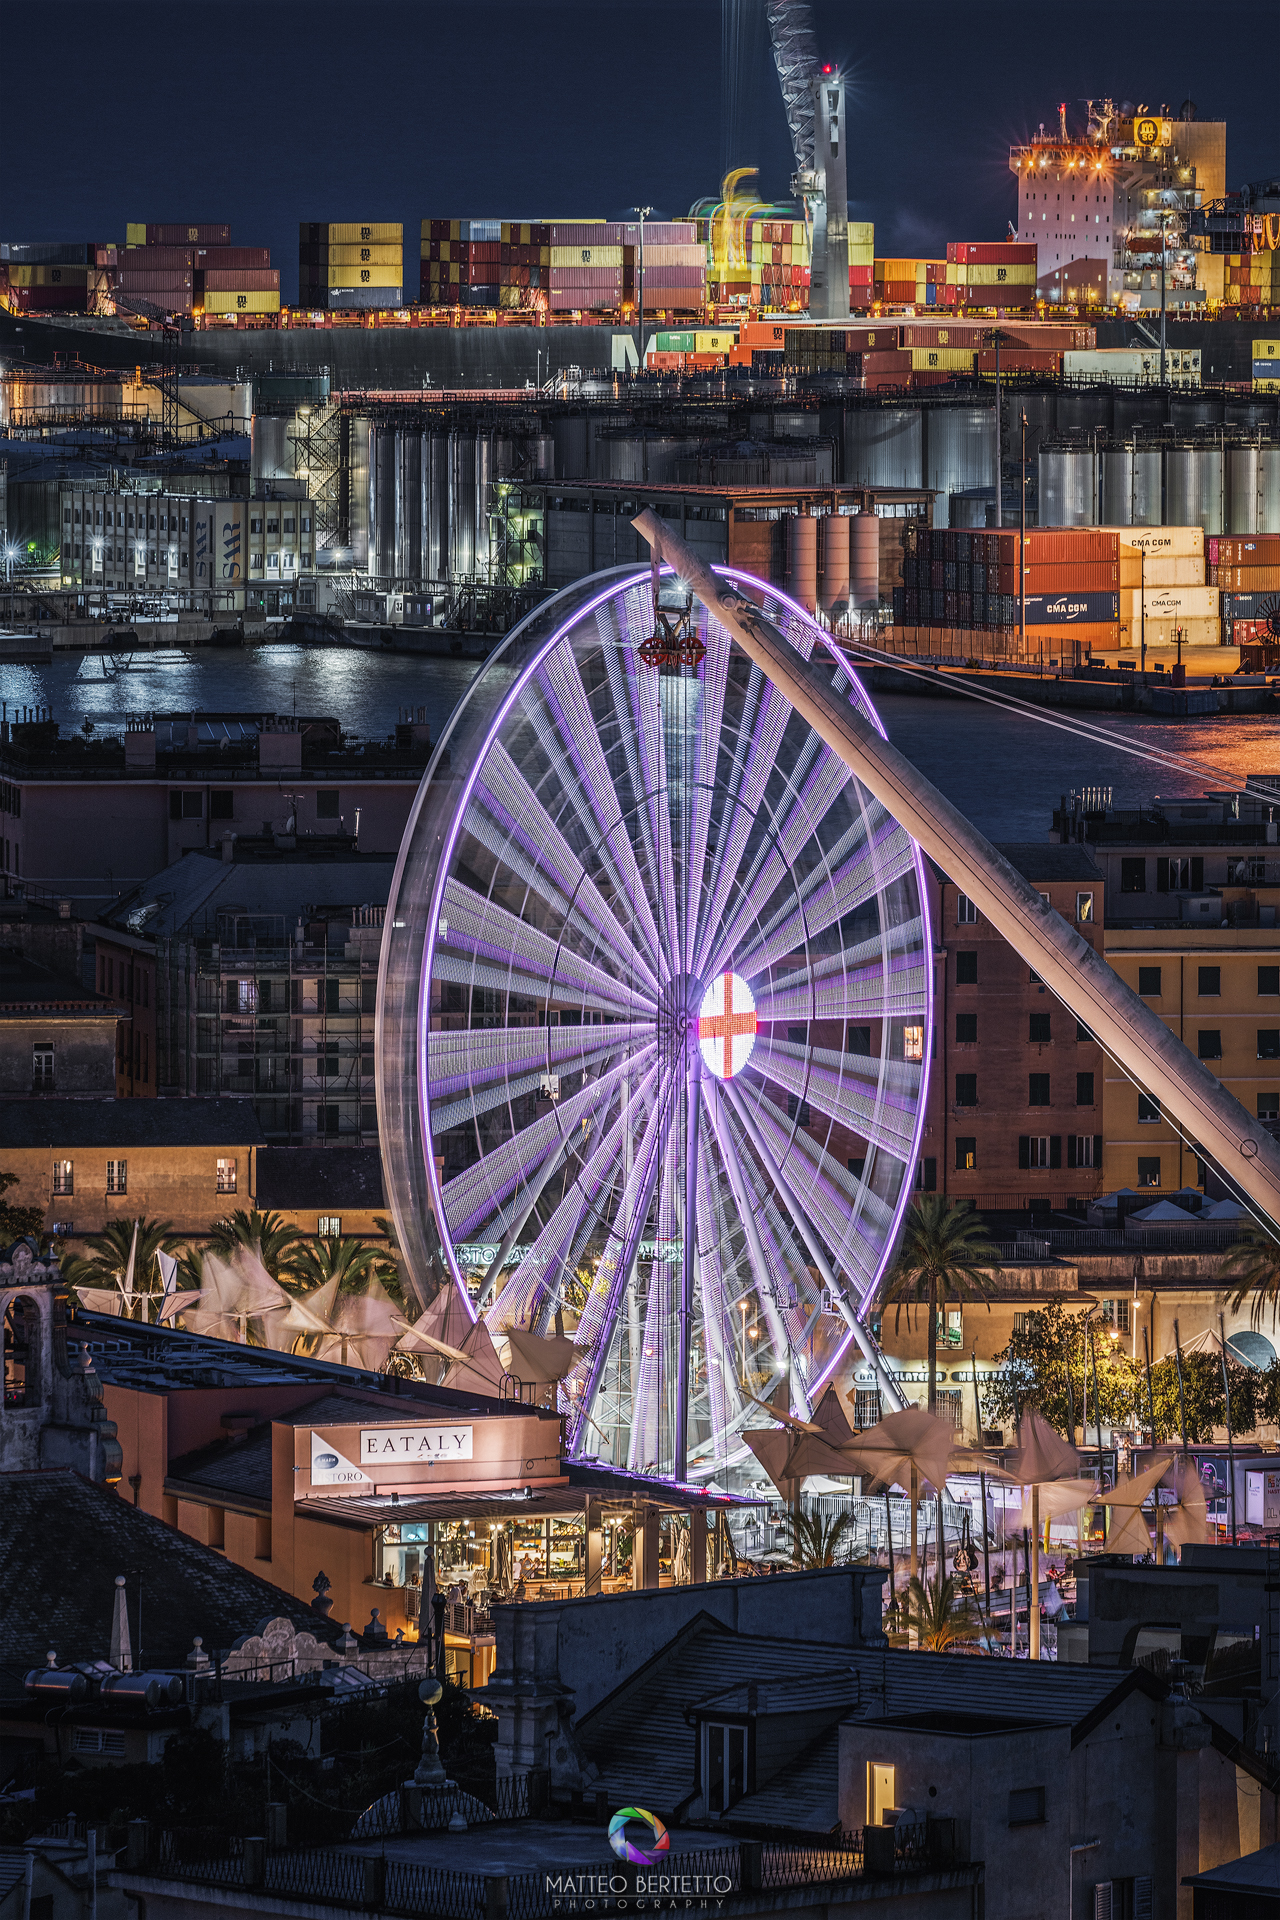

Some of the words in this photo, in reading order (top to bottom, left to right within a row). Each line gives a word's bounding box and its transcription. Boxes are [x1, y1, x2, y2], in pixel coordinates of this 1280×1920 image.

[1131, 539, 1150, 547] CMA
[1047, 604, 1067, 613] CMA
[1068, 603, 1088, 612] CGM
[367, 1434, 467, 1453] EATALY
